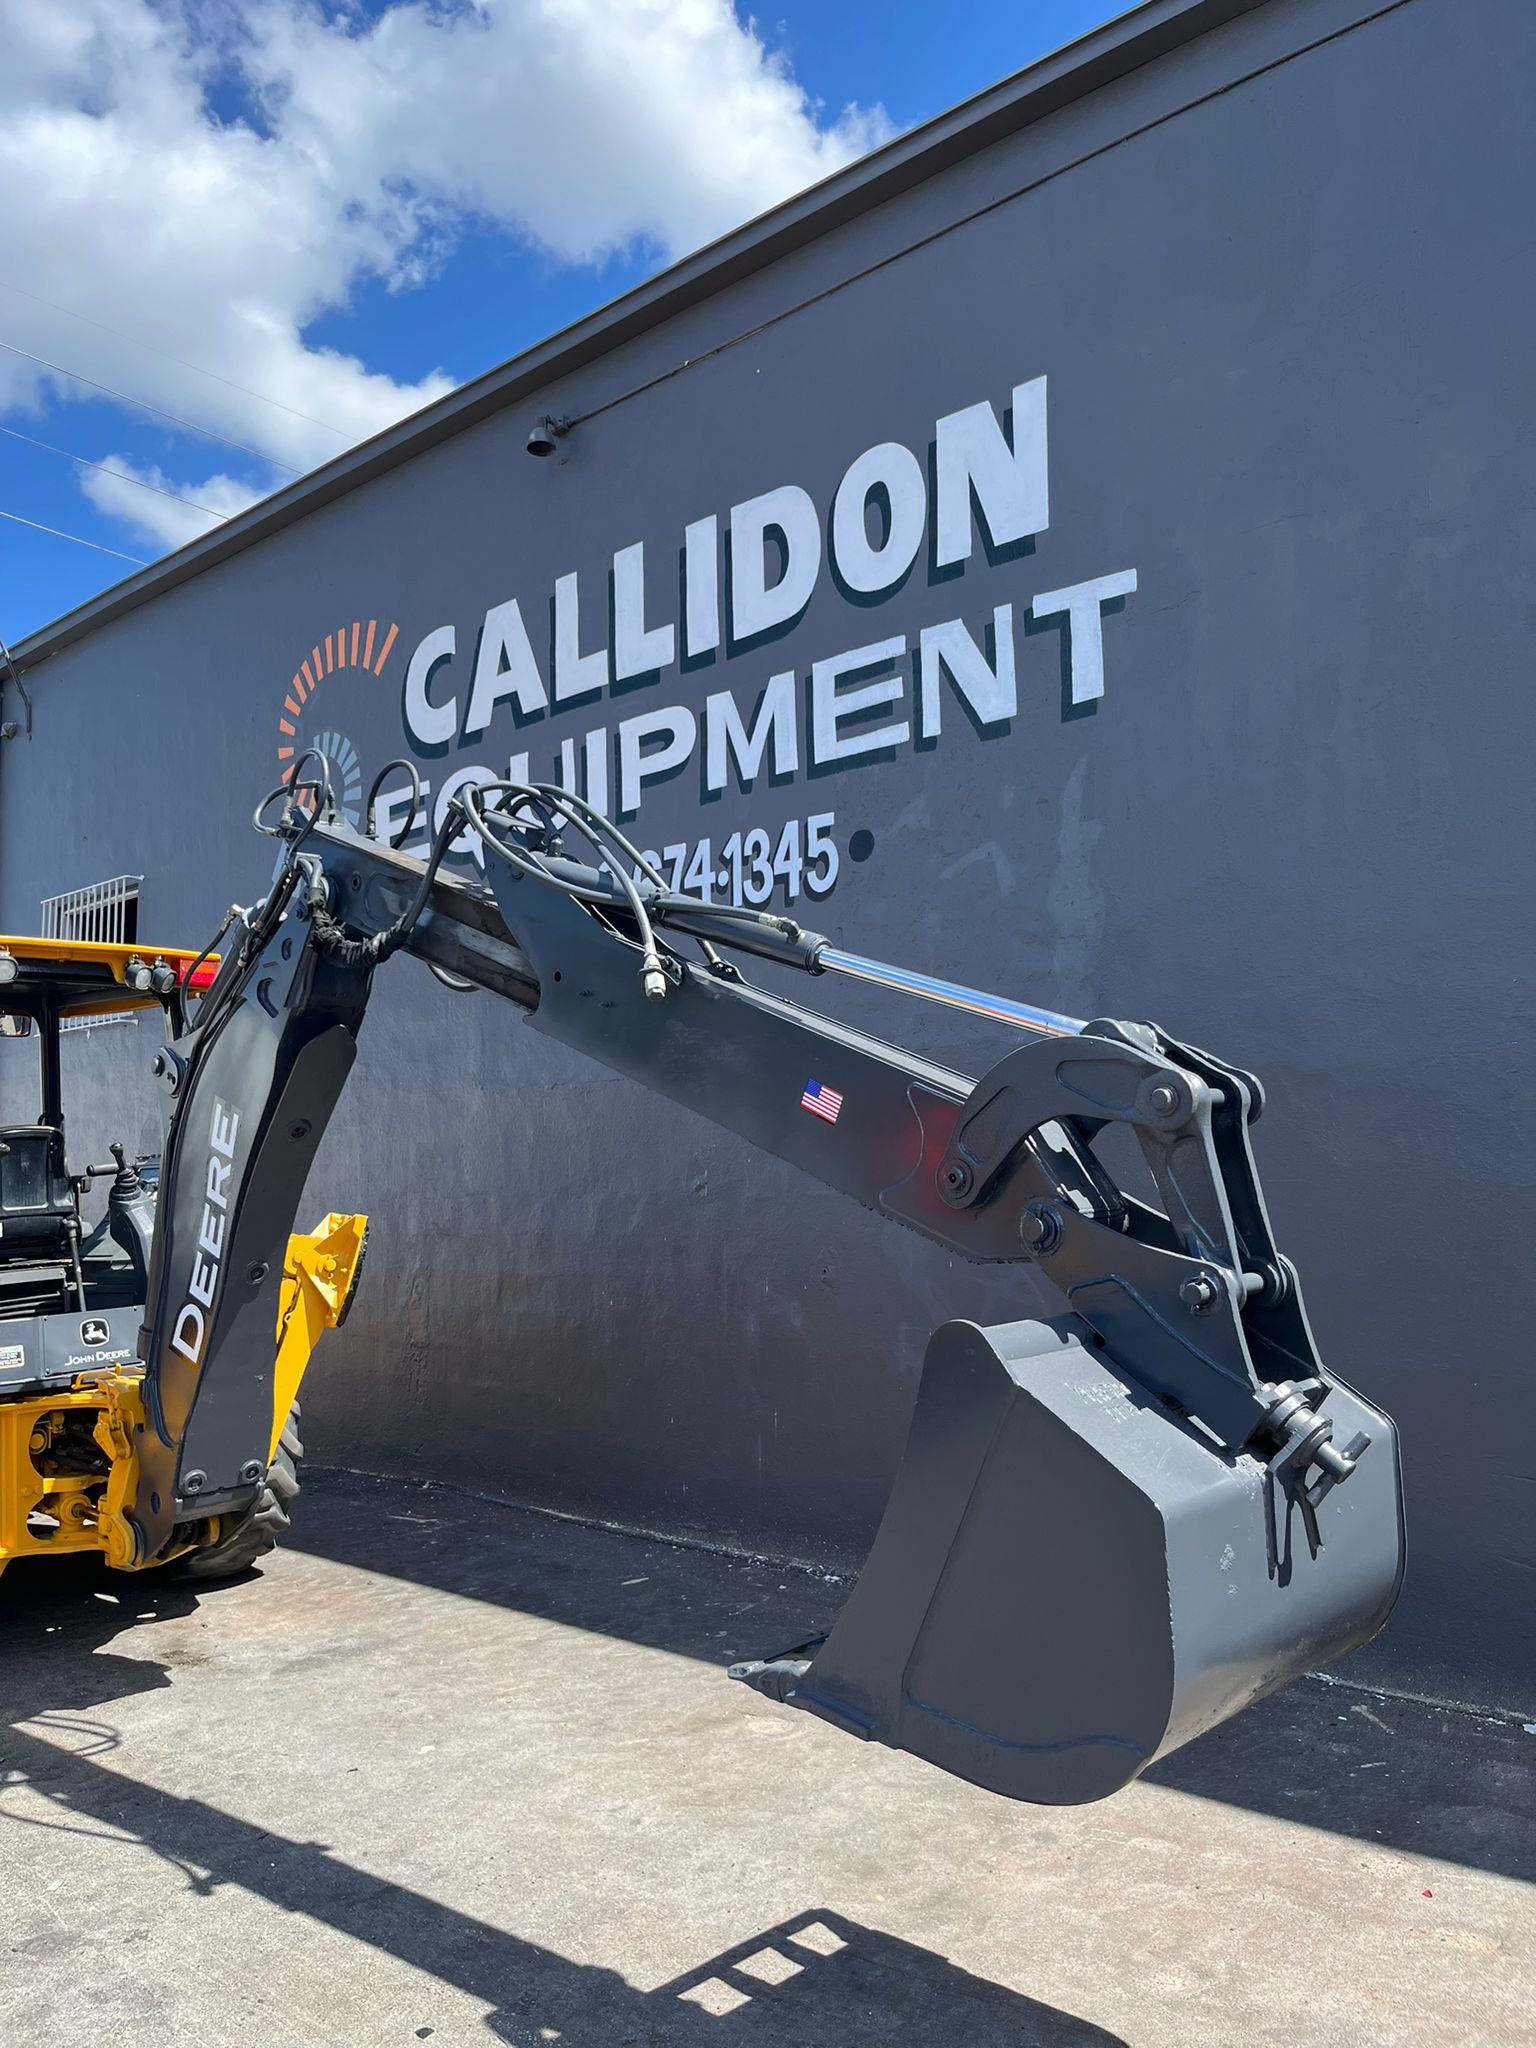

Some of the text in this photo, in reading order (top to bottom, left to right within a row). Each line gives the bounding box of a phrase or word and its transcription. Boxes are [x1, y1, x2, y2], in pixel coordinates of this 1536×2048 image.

[404, 374, 1049, 744] CALLIDON
[374, 568, 1138, 870] EQUIPMENT
[65, 1349, 132, 1366] JOHN DEERE
[172, 1103, 238, 1363] DEERE
